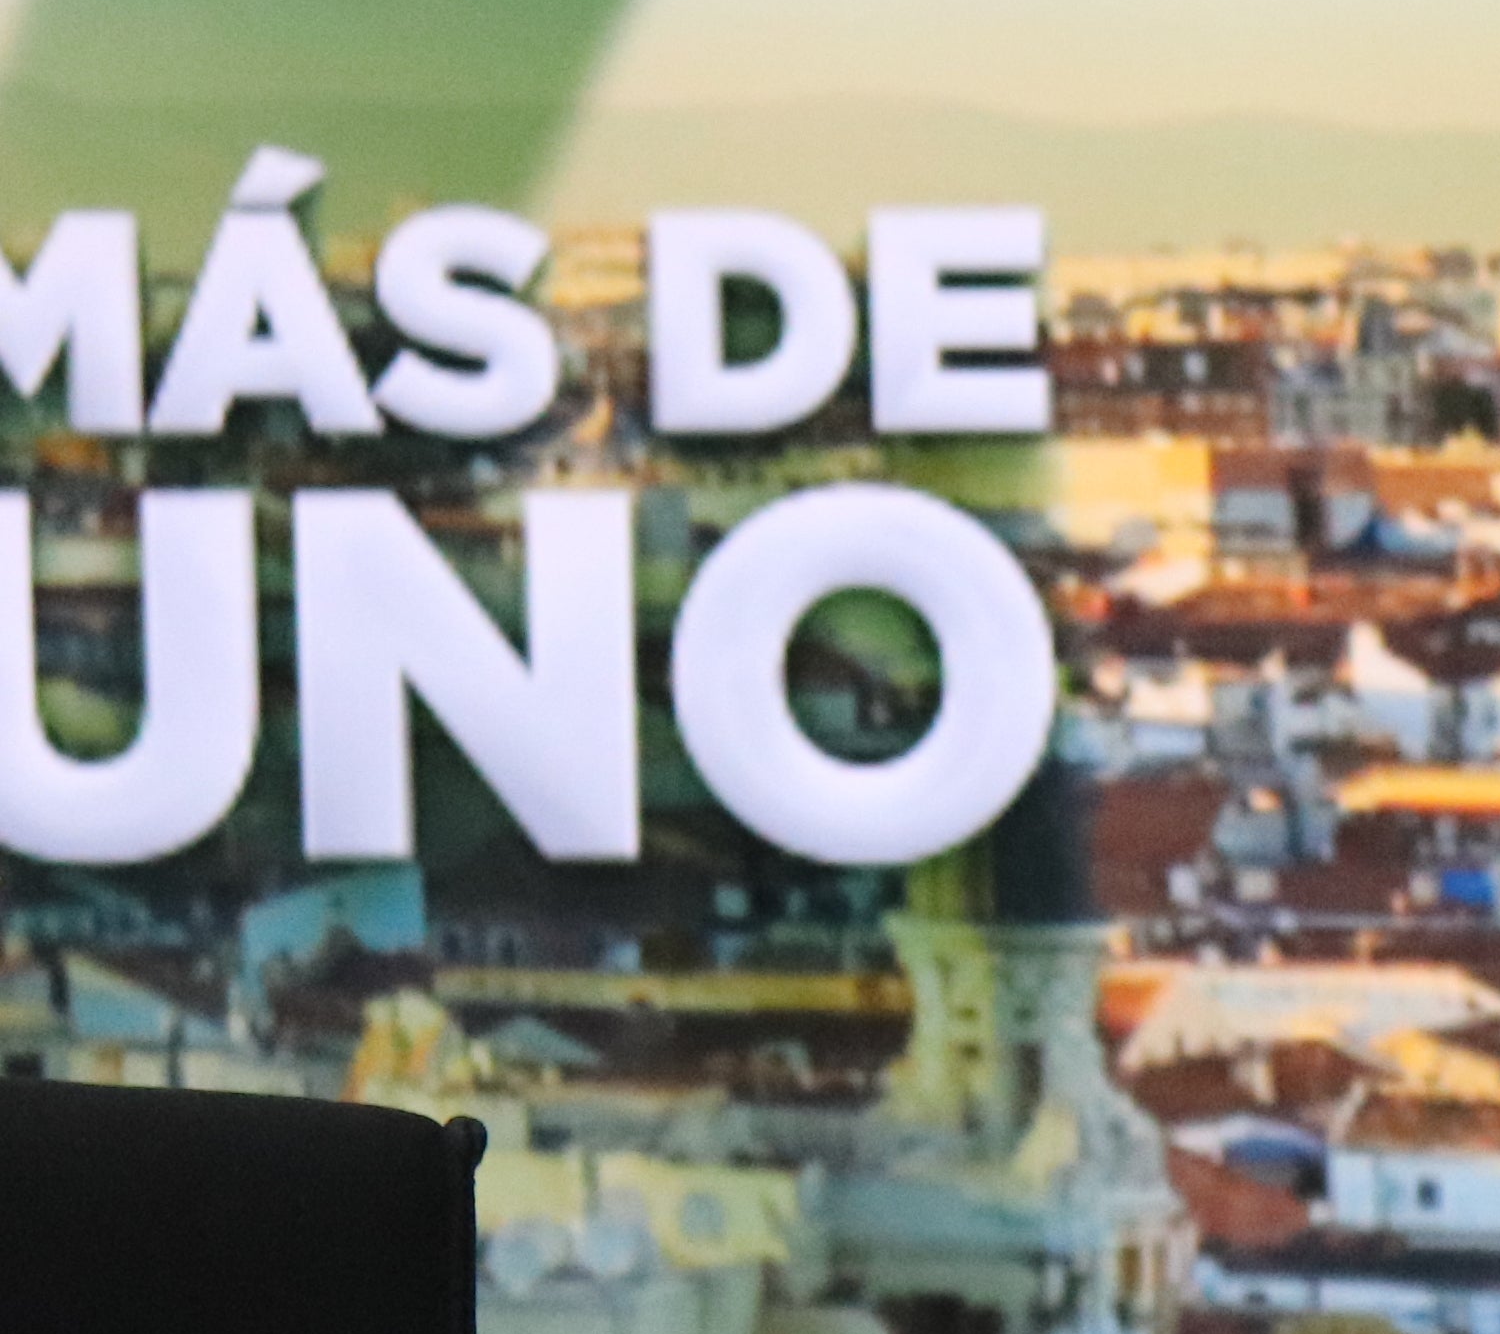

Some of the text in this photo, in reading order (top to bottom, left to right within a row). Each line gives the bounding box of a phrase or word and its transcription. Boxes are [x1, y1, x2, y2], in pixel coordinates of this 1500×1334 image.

[0, 145, 1052, 438] MÁS DE
[0, 482, 1056, 865] UNO
